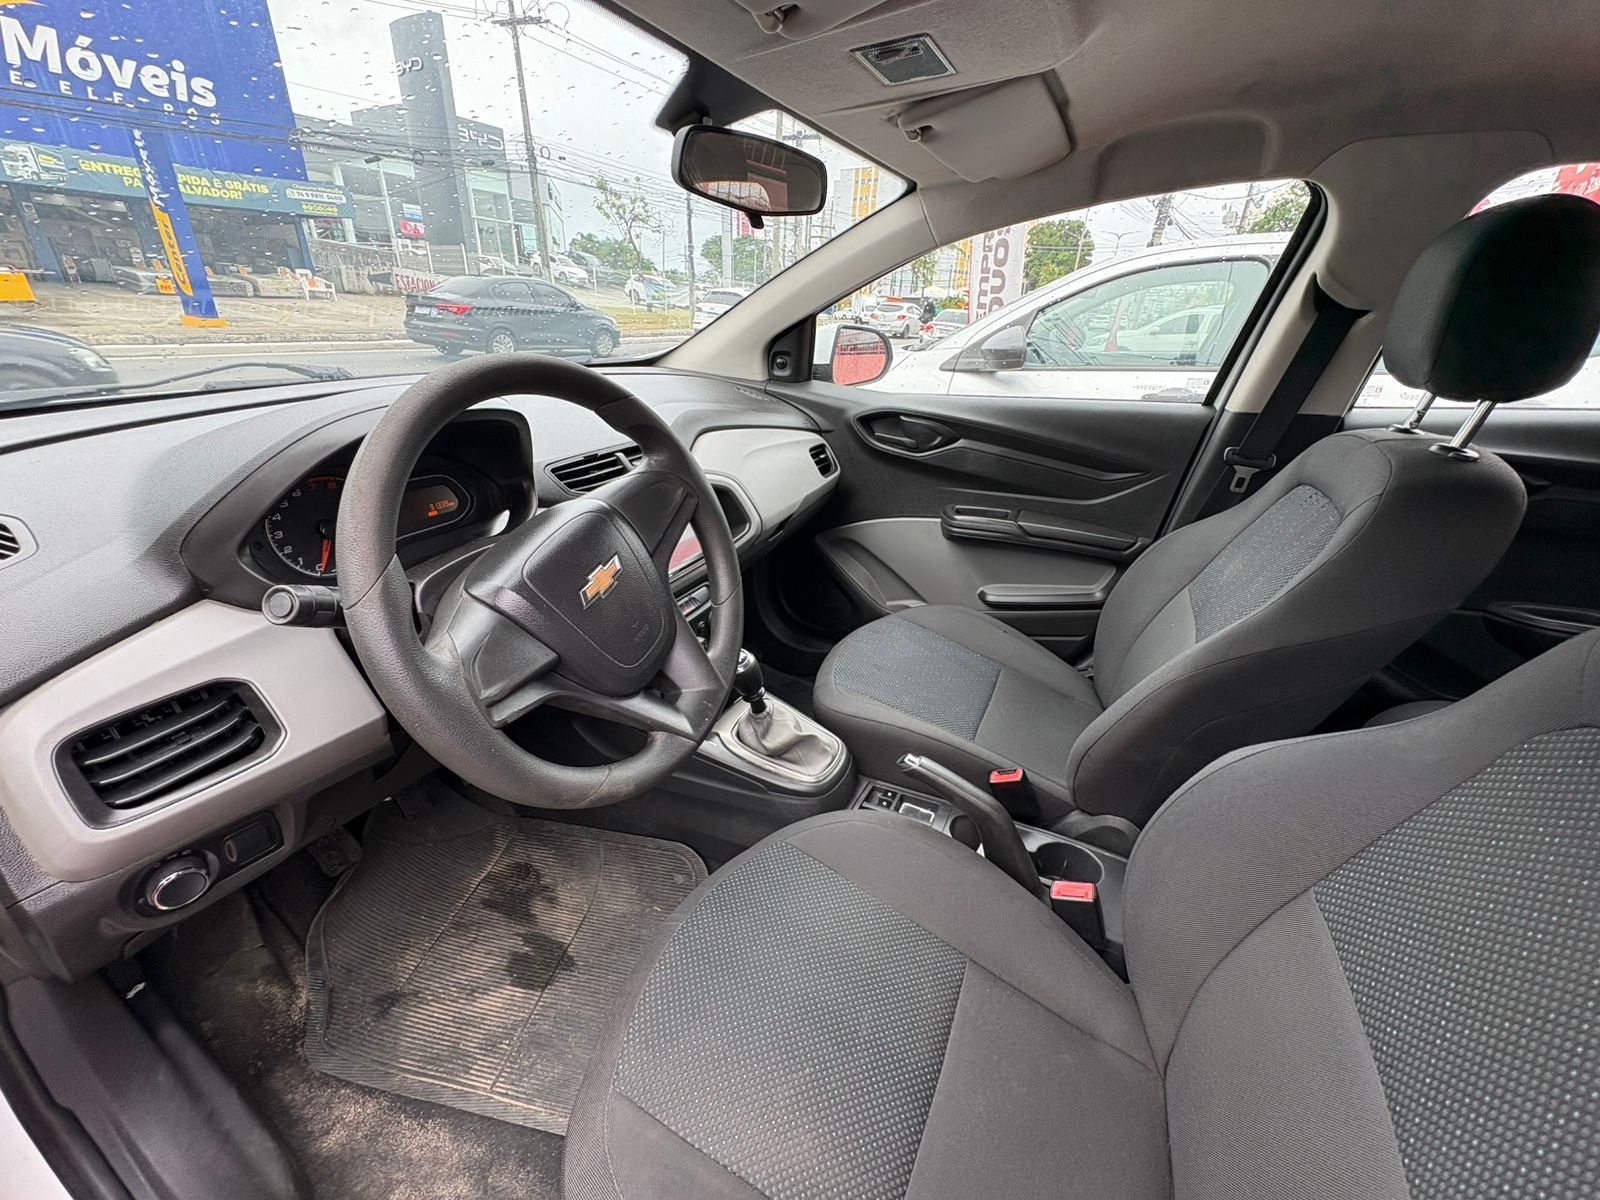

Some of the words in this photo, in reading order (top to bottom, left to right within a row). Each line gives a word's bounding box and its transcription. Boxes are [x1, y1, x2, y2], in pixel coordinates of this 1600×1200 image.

[0, 15, 217, 108] Móveis
[178, 183, 243, 201] ALVADOR!
[224, 180, 269, 195] GRÁTIS
[271, 512, 282, 521] 4
[273, 530, 284, 540] 3
